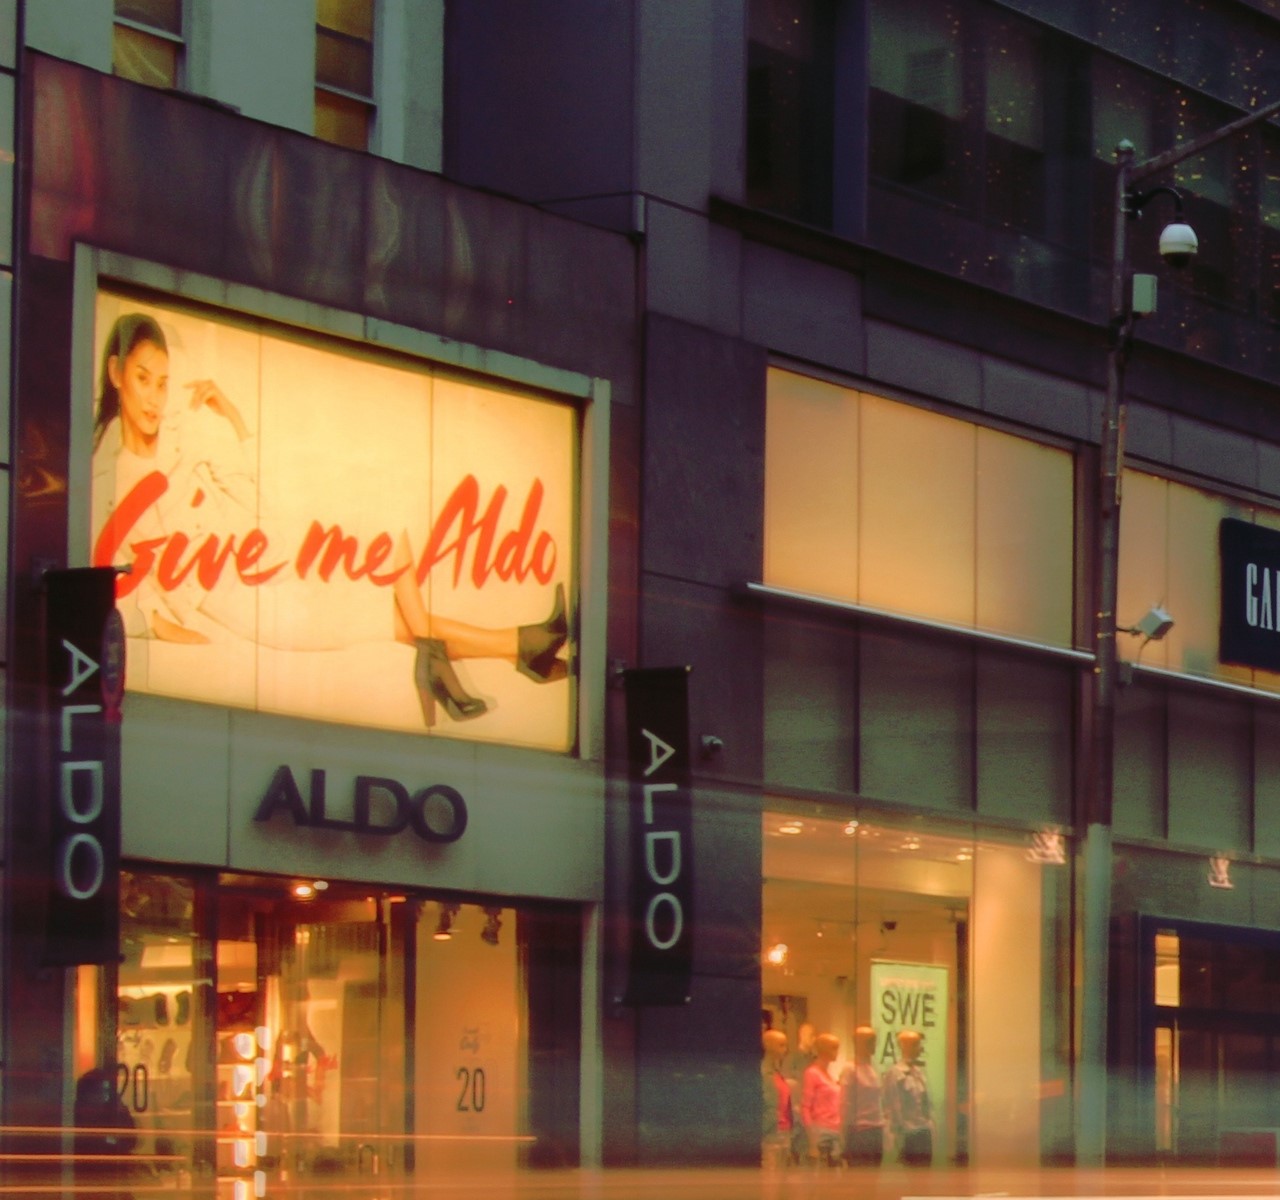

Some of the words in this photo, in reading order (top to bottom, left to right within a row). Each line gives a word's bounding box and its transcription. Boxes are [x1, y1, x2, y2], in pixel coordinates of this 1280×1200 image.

[92, 470, 287, 600] Give
[296, 520, 414, 584] me
[415, 474, 557, 589] Aldo
[61, 638, 104, 900] ALDO
[253, 764, 469, 844] ALDO
[642, 728, 682, 949] ALDO
[881, 989, 936, 1027] SWE
[456, 1066, 485, 1112] 20
